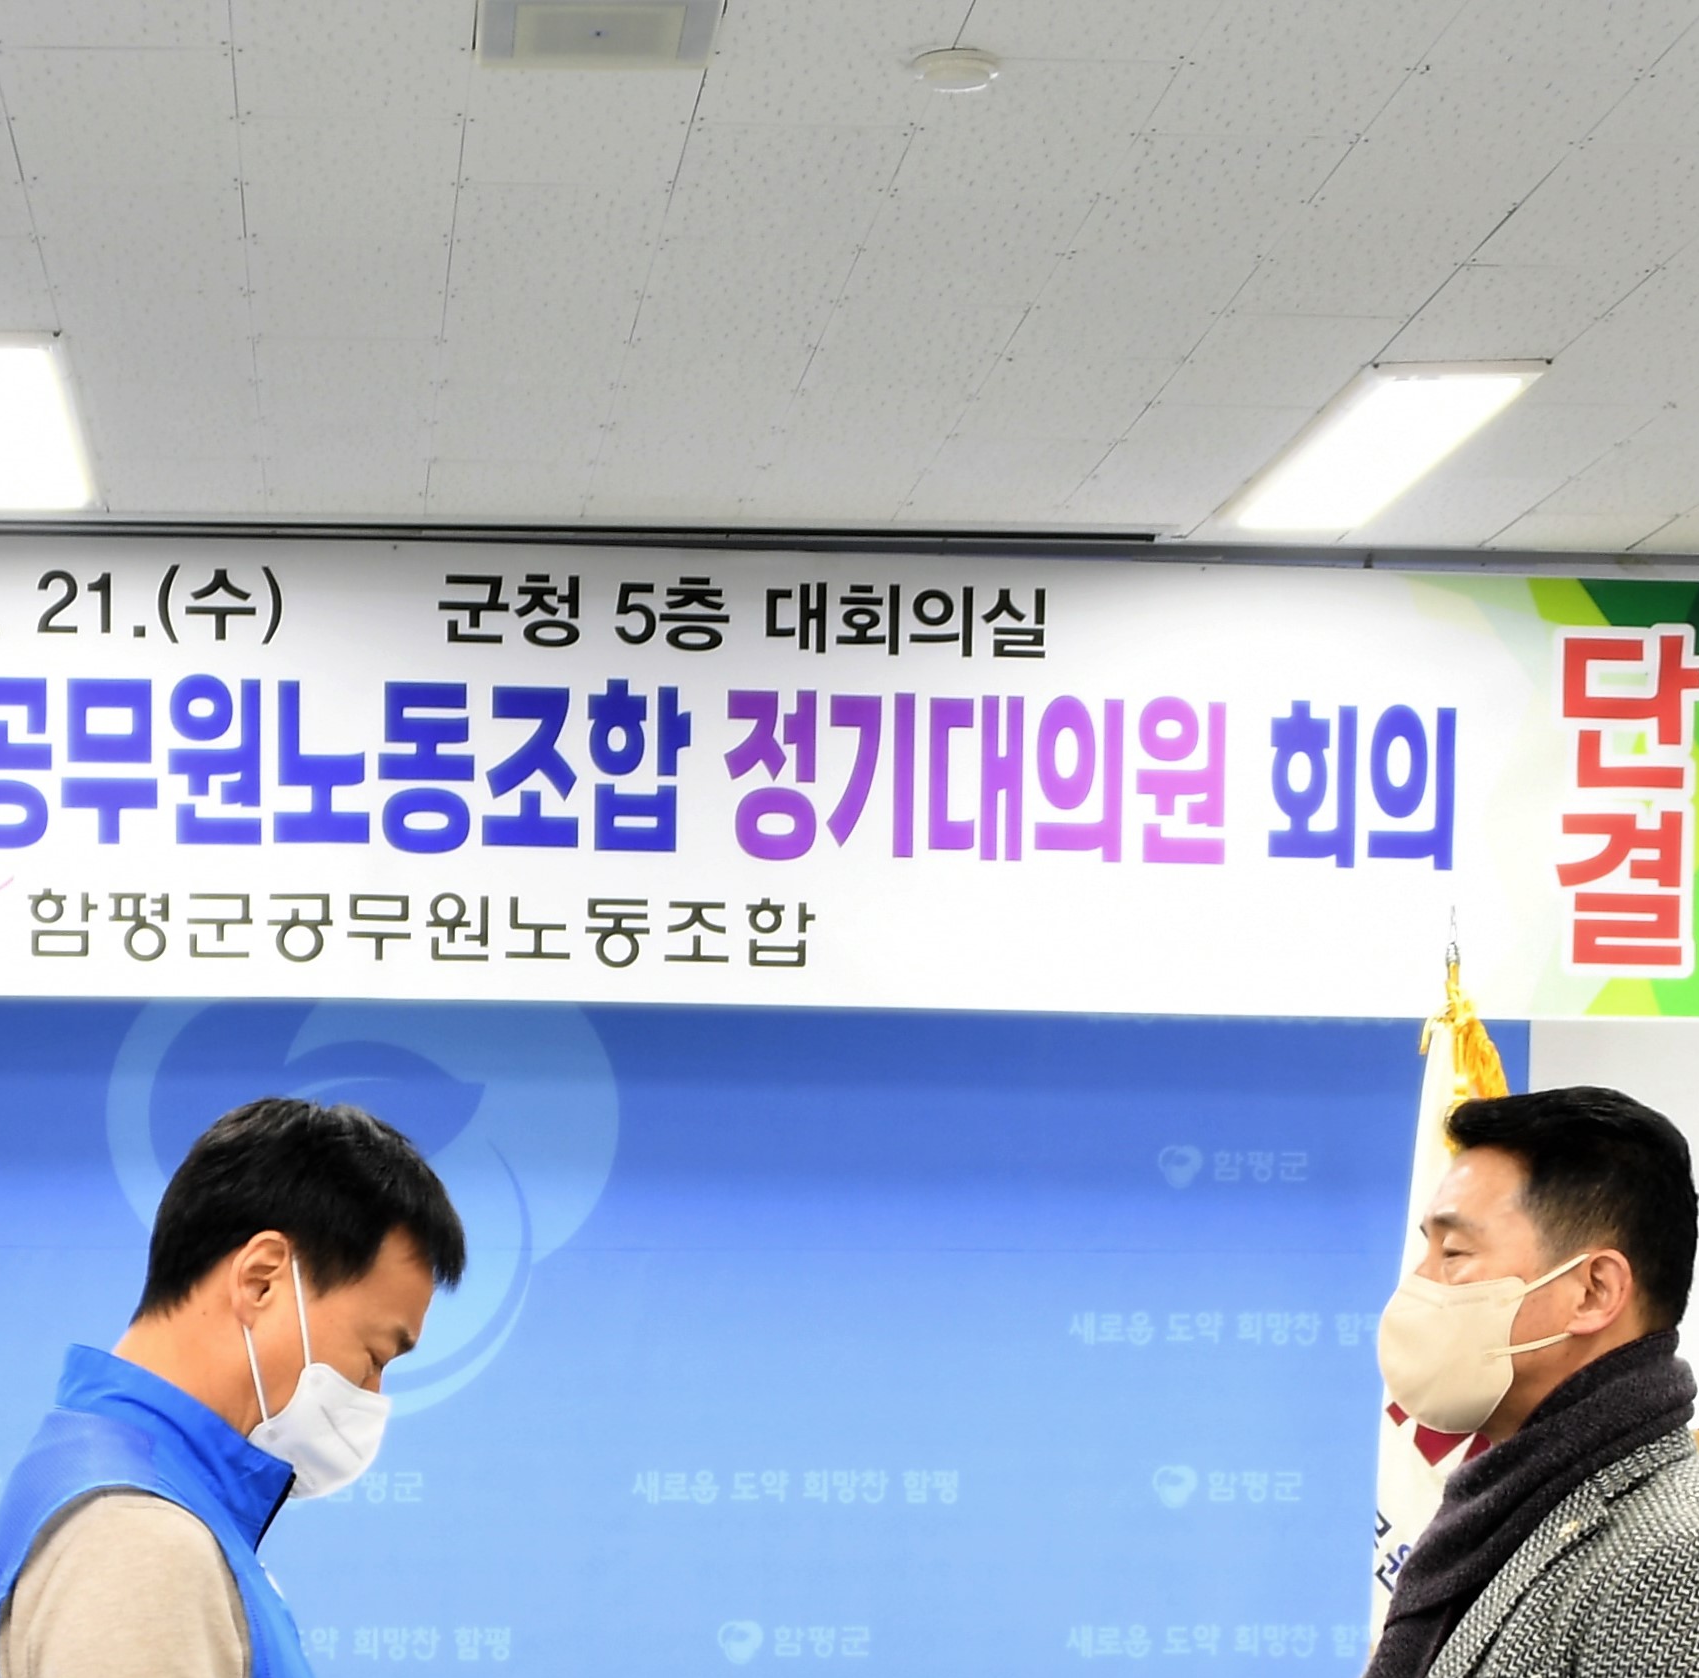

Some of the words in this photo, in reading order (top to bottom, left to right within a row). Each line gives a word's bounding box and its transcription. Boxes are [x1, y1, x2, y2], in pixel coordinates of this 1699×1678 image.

[35, 564, 285, 645] 21.(수)
[436, 571, 581, 648] 군청
[614, 576, 731, 652] 5층
[765, 581, 1049, 659] 대회의실
[724, 687, 1228, 865] 정기대의원
[1266, 699, 1458, 872] 회의
[26, 887, 816, 969] 함평군공무원노동조합
[1212, 1150, 1309, 1184] 함평군
[1068, 1309, 1156, 1346] 새로운
[1166, 1309, 1224, 1345] 도약
[631, 1468, 720, 1506] 새로운
[729, 1468, 790, 1504] 도약
[902, 1468, 960, 1505] 함평
[1207, 1470, 1304, 1504] 함평군
[453, 1626, 512, 1662] 함평
[773, 1625, 871, 1660] 함평군
[1066, 1623, 1152, 1659] 새로운
[1162, 1623, 1222, 1658] 도약
